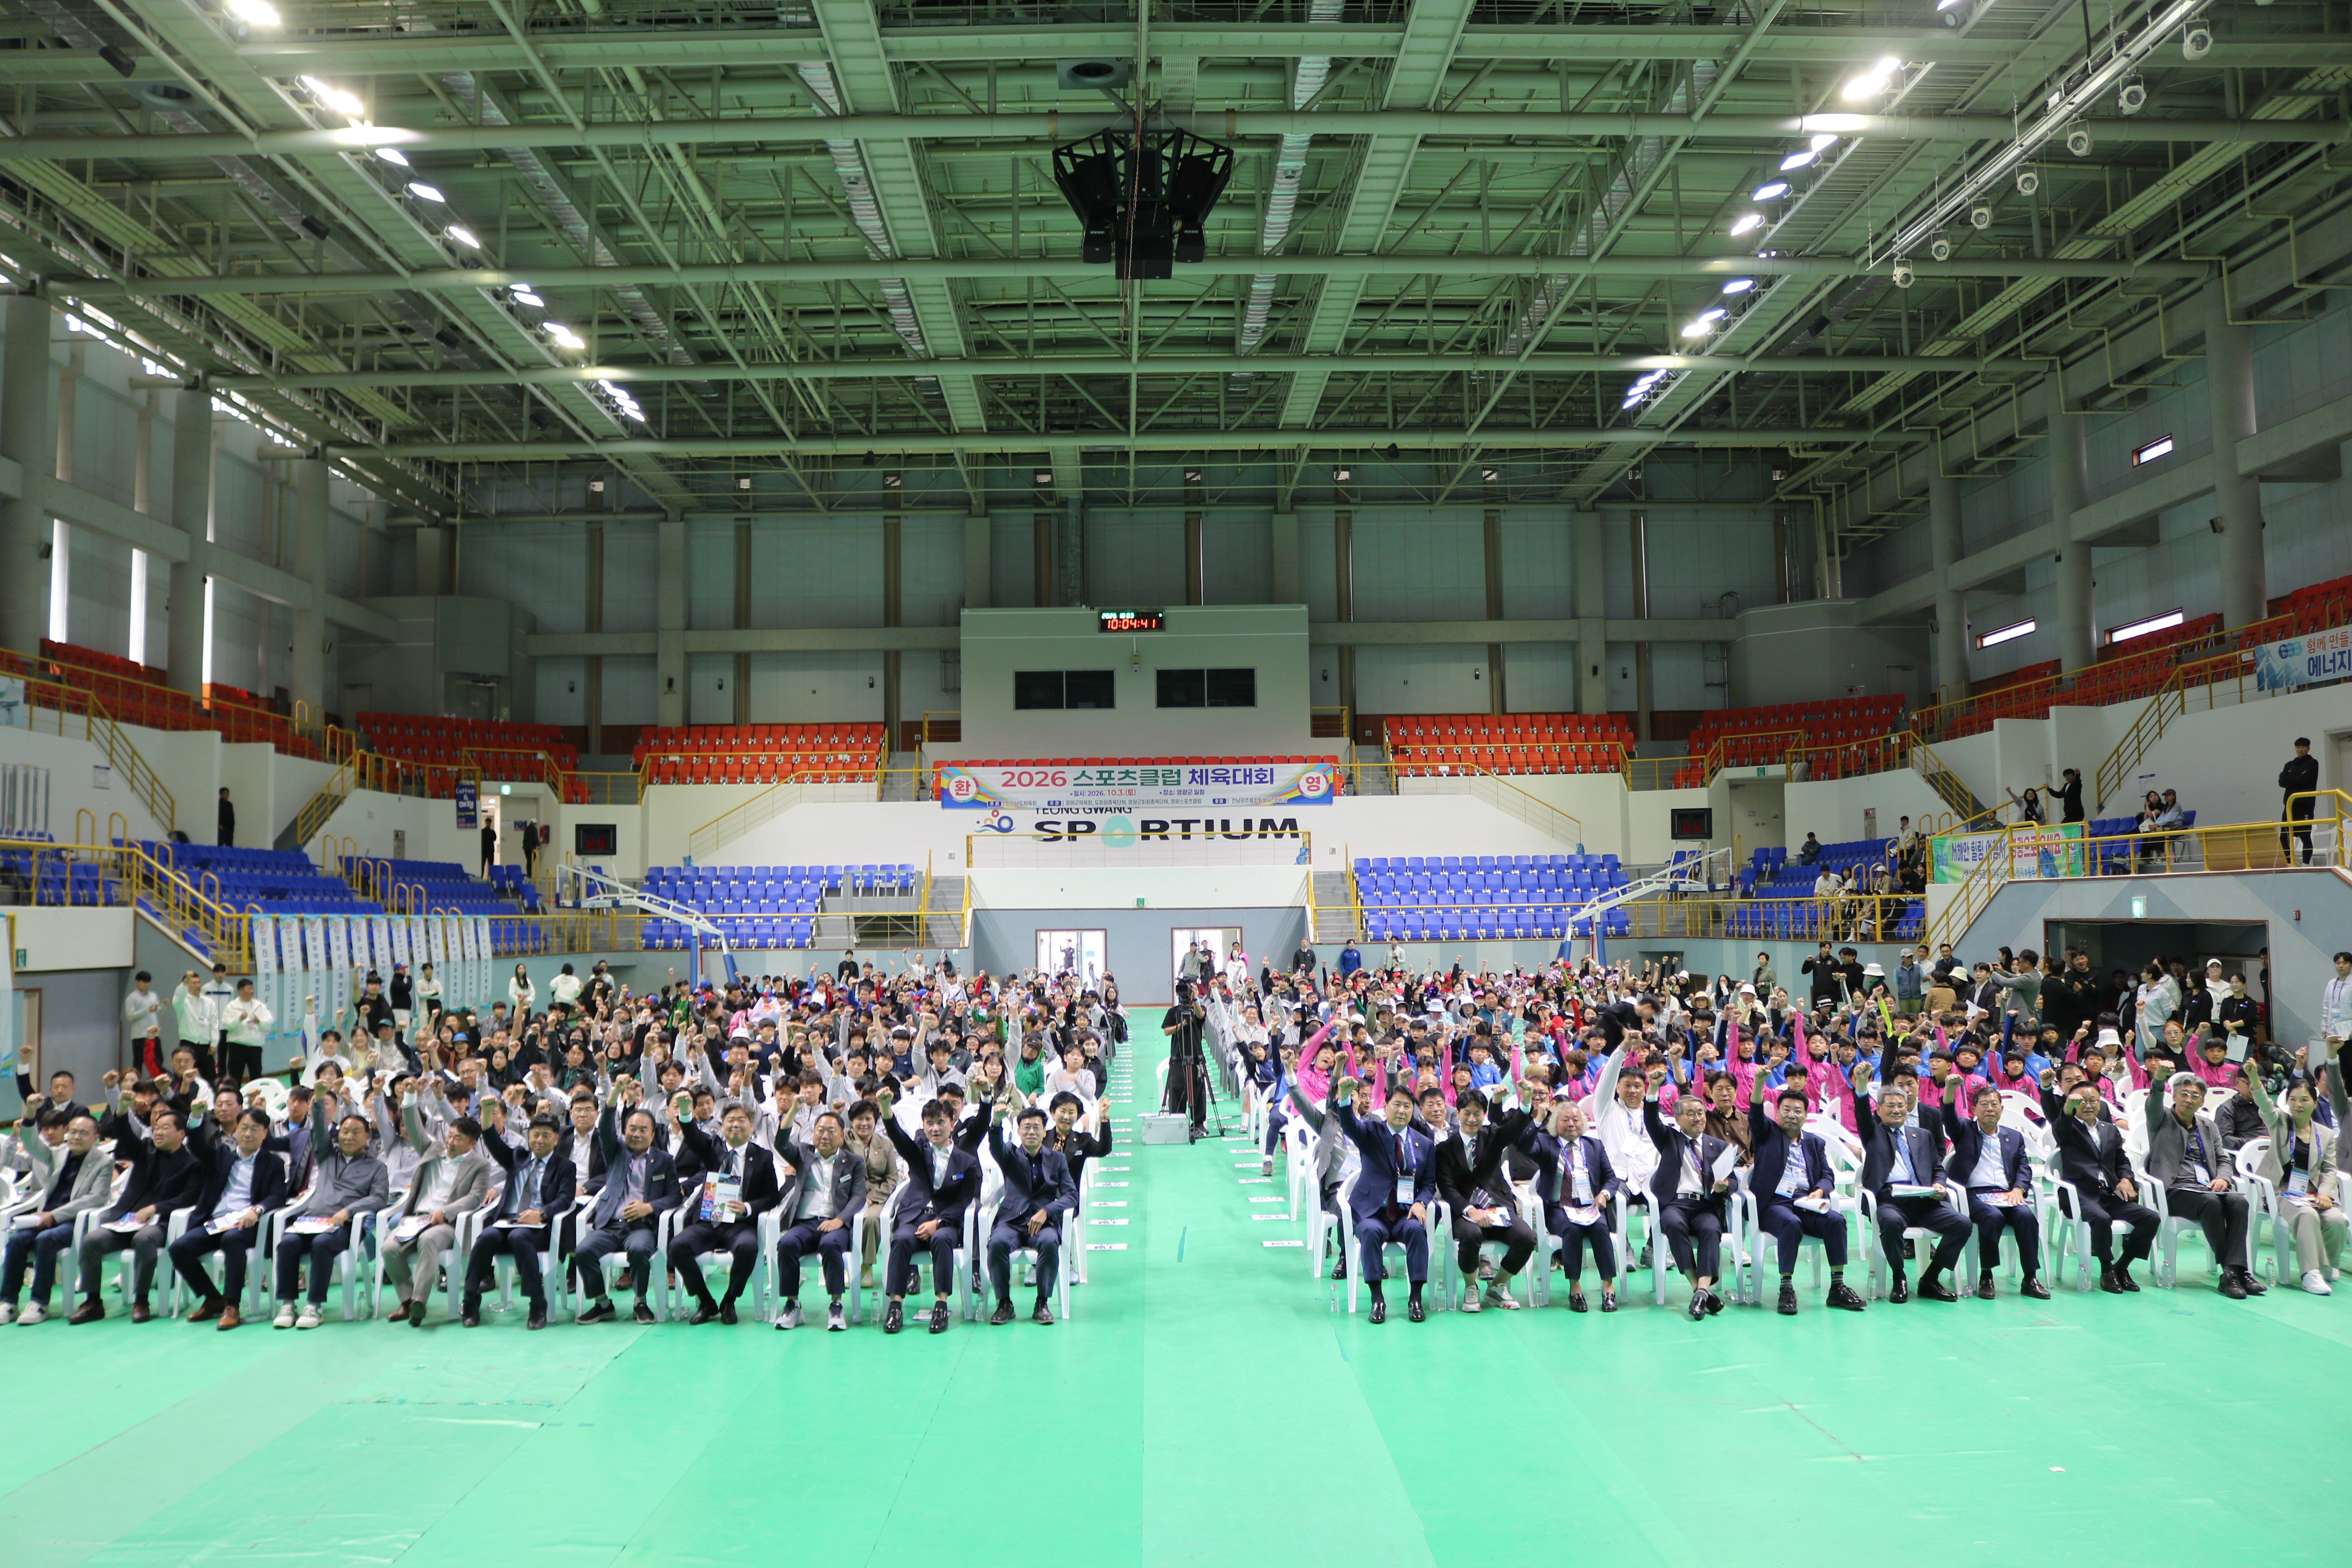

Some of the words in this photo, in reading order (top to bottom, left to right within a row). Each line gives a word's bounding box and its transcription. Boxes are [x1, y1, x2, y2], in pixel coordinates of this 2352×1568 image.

[1107, 619, 1156, 630] 10:04:41
[2307, 635, 2326, 654] 함께
[2329, 631, 2352, 649] 만들
[2308, 649, 2351, 677] 에너지
[1001, 771, 1067, 787] 2026
[1073, 769, 1181, 787] 스포츠클럽
[1188, 768, 1274, 786] 체육대회
[1305, 776, 1321, 792] 영
[954, 780, 971, 797] 환
[1952, 842, 1969, 862] 서해안
[261, 937, 270, 1004] 강진군청자F
